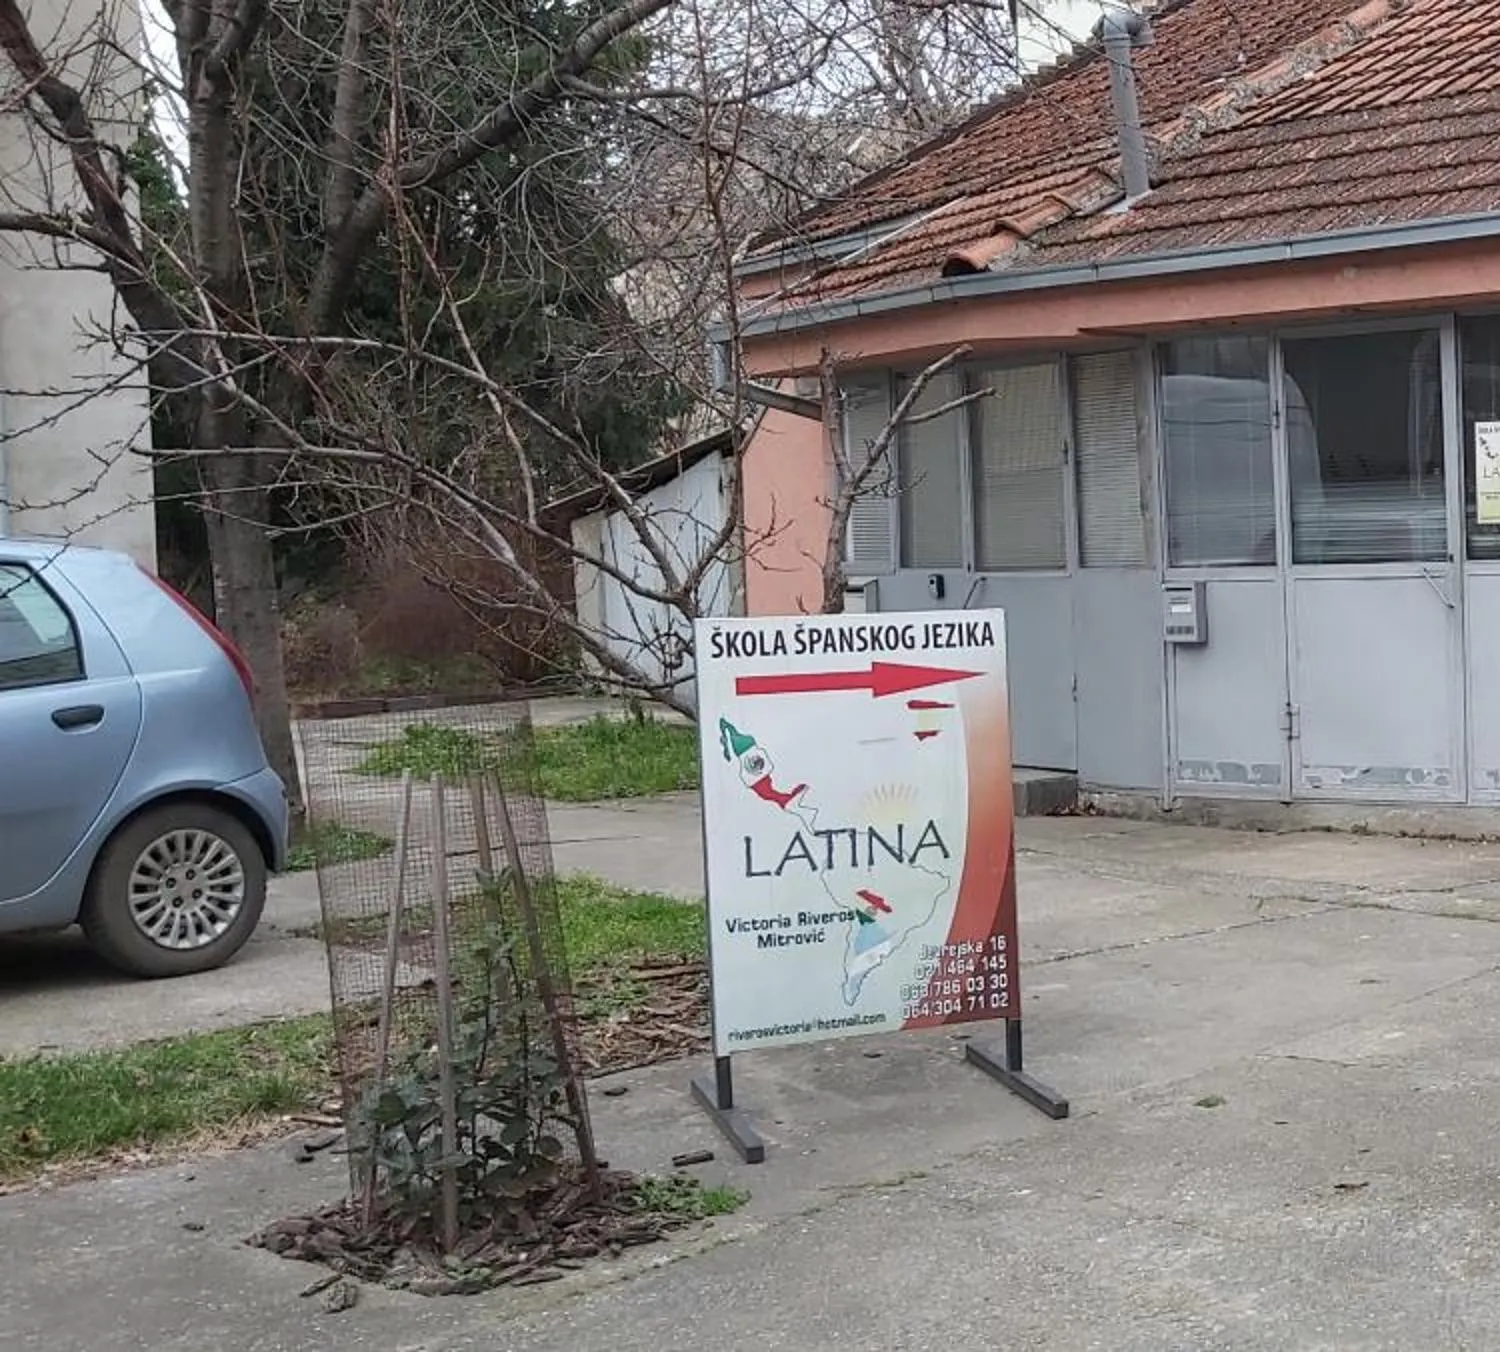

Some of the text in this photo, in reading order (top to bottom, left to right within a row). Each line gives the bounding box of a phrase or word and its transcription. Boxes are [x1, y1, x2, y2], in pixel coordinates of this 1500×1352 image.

[711, 621, 995, 659] ŠKOLA ŠPANSKOG JEZIKA
[744, 819, 950, 877] LATINA
[725, 911, 855, 933] Victoria Riveros
[757, 928, 826, 948] Mitrović
[982, 954, 1007, 971] 145
[966, 976, 985, 993] 03
[989, 973, 1009, 989] 30
[967, 995, 985, 1012] 71
[990, 992, 1009, 1008] 02
